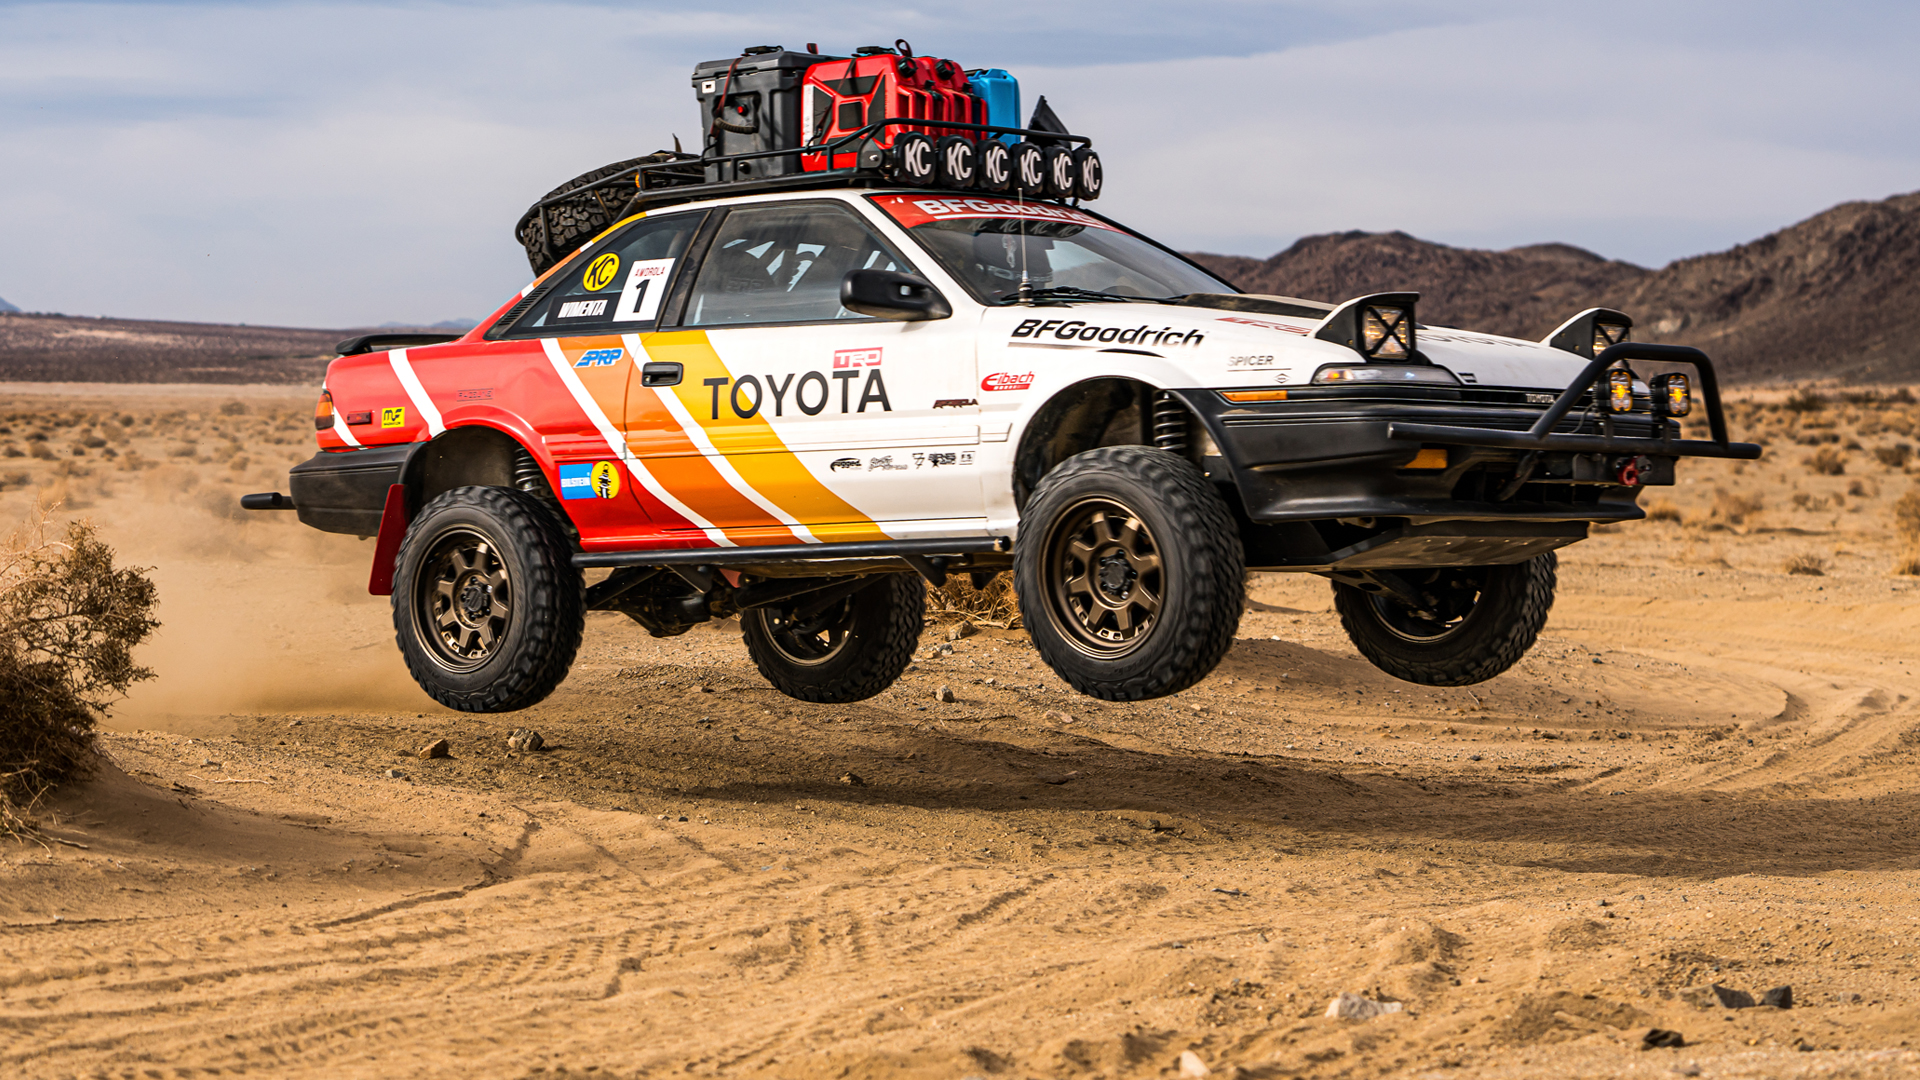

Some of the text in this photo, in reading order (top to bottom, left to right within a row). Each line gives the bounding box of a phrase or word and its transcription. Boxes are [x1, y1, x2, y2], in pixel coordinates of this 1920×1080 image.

[905, 139, 931, 177] KC
[947, 142, 972, 180] KC
[986, 146, 1008, 184] KC
[1020, 149, 1042, 187] KC
[1053, 153, 1073, 190] KC
[1082, 156, 1100, 192] KC
[587, 255, 615, 288] KC
[632, 279, 651, 314] 1
[1011, 319, 1205, 348] BFGoodrich
[574, 348, 624, 368] PRP
[834, 349, 882, 368] TRD
[1227, 355, 1275, 367] SPICER
[703, 368, 893, 420] TOYOTA
[981, 371, 1036, 392] Eibach
